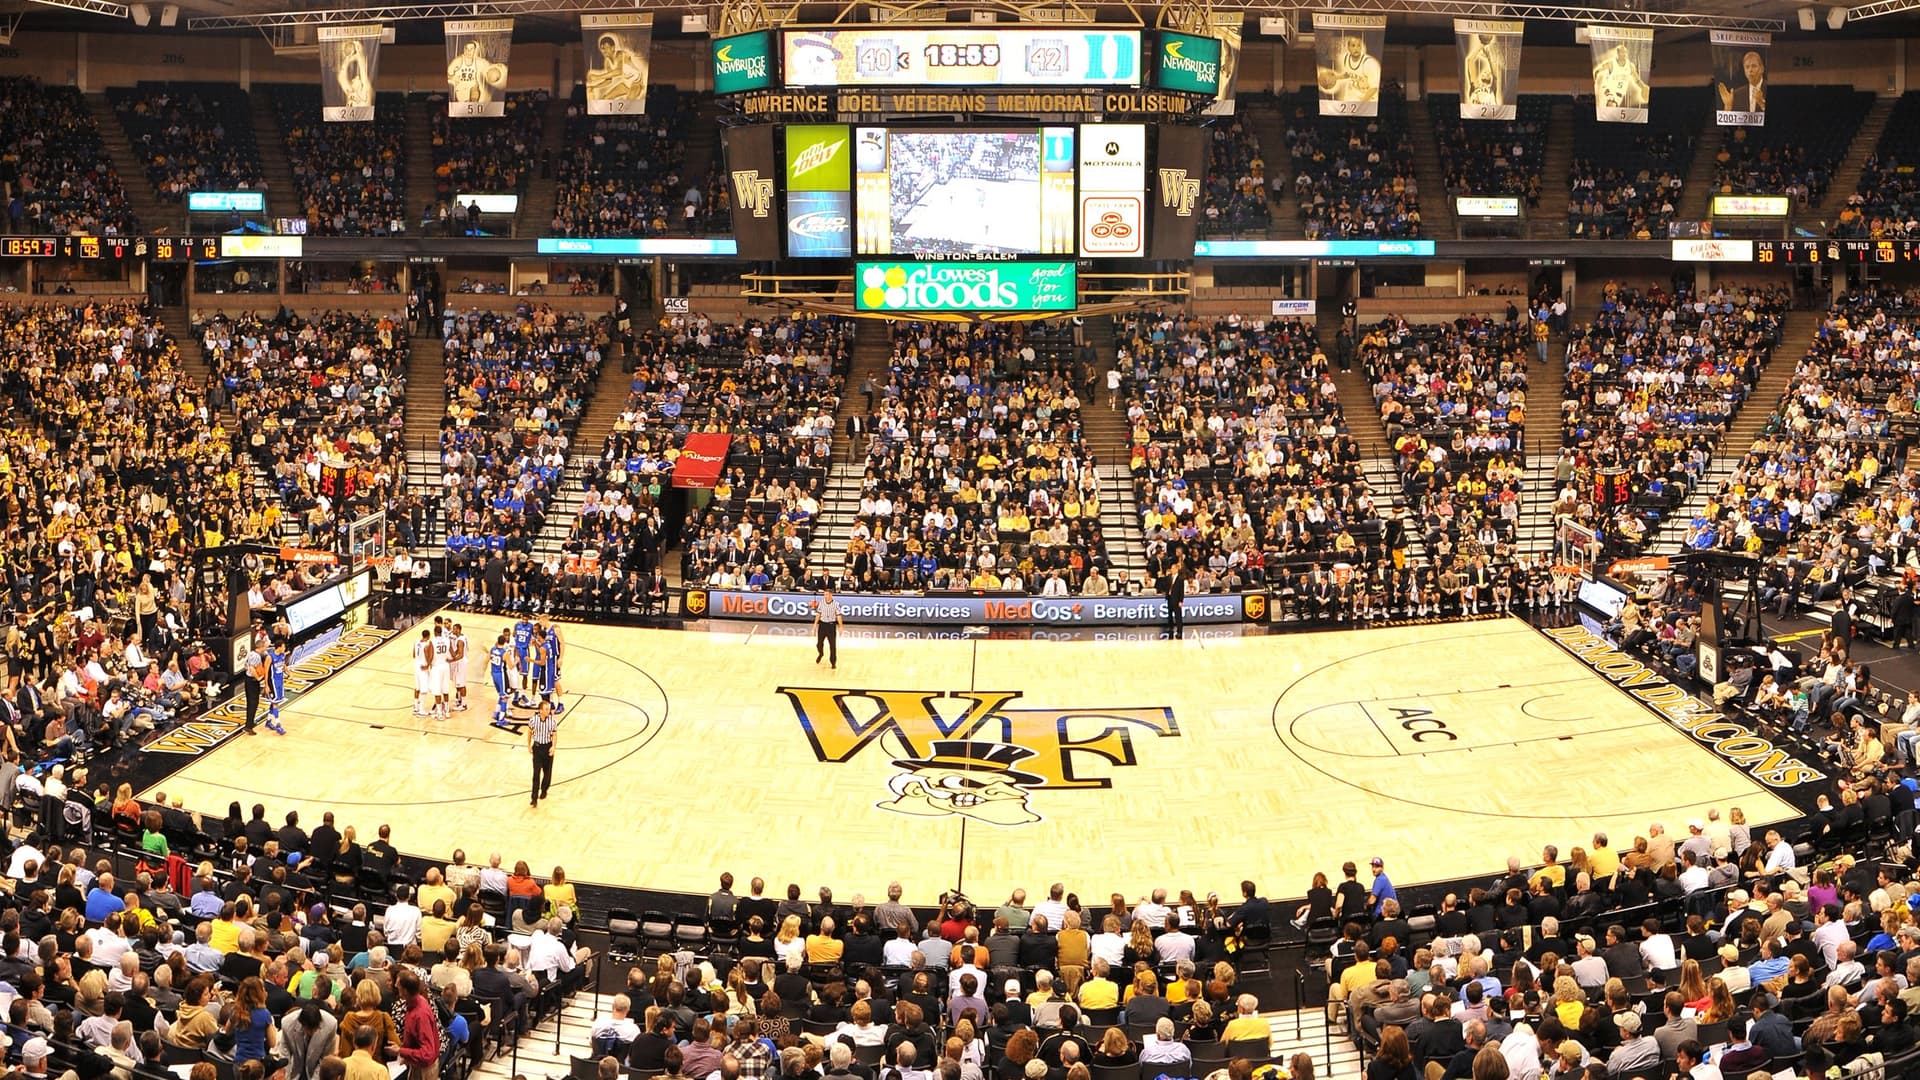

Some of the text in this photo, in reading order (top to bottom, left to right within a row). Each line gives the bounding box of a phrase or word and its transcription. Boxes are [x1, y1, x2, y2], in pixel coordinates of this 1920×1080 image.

[1316, 14, 1384, 26] CHILDRESS
[860, 48, 892, 72] 40
[924, 43, 1000, 67] 18:59
[1030, 46, 1062, 72] 42
[746, 66, 767, 79] BANK
[1196, 71, 1216, 84] BANK
[467, 105, 484, 115] 50
[608, 102, 624, 112] 12
[743, 95, 1186, 115] LAWRENCE JOEL VETERANS MEMORIAL COLISEUM
[1340, 103, 1357, 114] 22
[340, 109, 356, 119] 24
[1480, 106, 1497, 117] 21
[1619, 110, 1626, 120] 5
[1082, 160, 1142, 168] MOTOROLA
[8, 240, 52, 256] 18:59 2
[118, 239, 129, 247] FLS
[157, 238, 216, 246] PLR FLS PTS
[1758, 242, 1817, 250] PLR FLS PTS
[1857, 242, 1869, 250] FLS
[64, 246, 72, 257] 4
[83, 246, 98, 257] 42
[114, 246, 122, 258] 0
[157, 246, 172, 258] 30
[205, 246, 217, 258] 12
[913, 252, 1018, 261] WINSTON-SALEM
[1758, 250, 1774, 263] 30
[1809, 250, 1818, 262] 8
[1879, 251, 1895, 262] 40
[1903, 251, 1911, 262] 4
[926, 264, 986, 283] Lowes
[1029, 264, 1066, 285] good
[904, 269, 1018, 309] foods
[1035, 278, 1061, 299] for
[665, 298, 688, 308] ACC
[1031, 294, 1068, 310] you
[687, 452, 726, 463] Allegacy
[321, 475, 335, 496] 35
[1614, 483, 1629, 504] 35
[688, 594, 706, 610] ups
[1246, 601, 1265, 614] ups
[835, 600, 892, 618] enefit
[894, 602, 971, 619] Services
[983, 600, 1235, 621] MedCost Benefit Srvices
[436, 645, 447, 655] 30
[283, 624, 400, 693] FOREST
[1542, 624, 1669, 688] DEMON
[1629, 682, 1827, 788] DEACONS
[1388, 707, 1458, 742] ACC
[775, 685, 1182, 789] WF
[1186, 910, 1195, 921] 5
